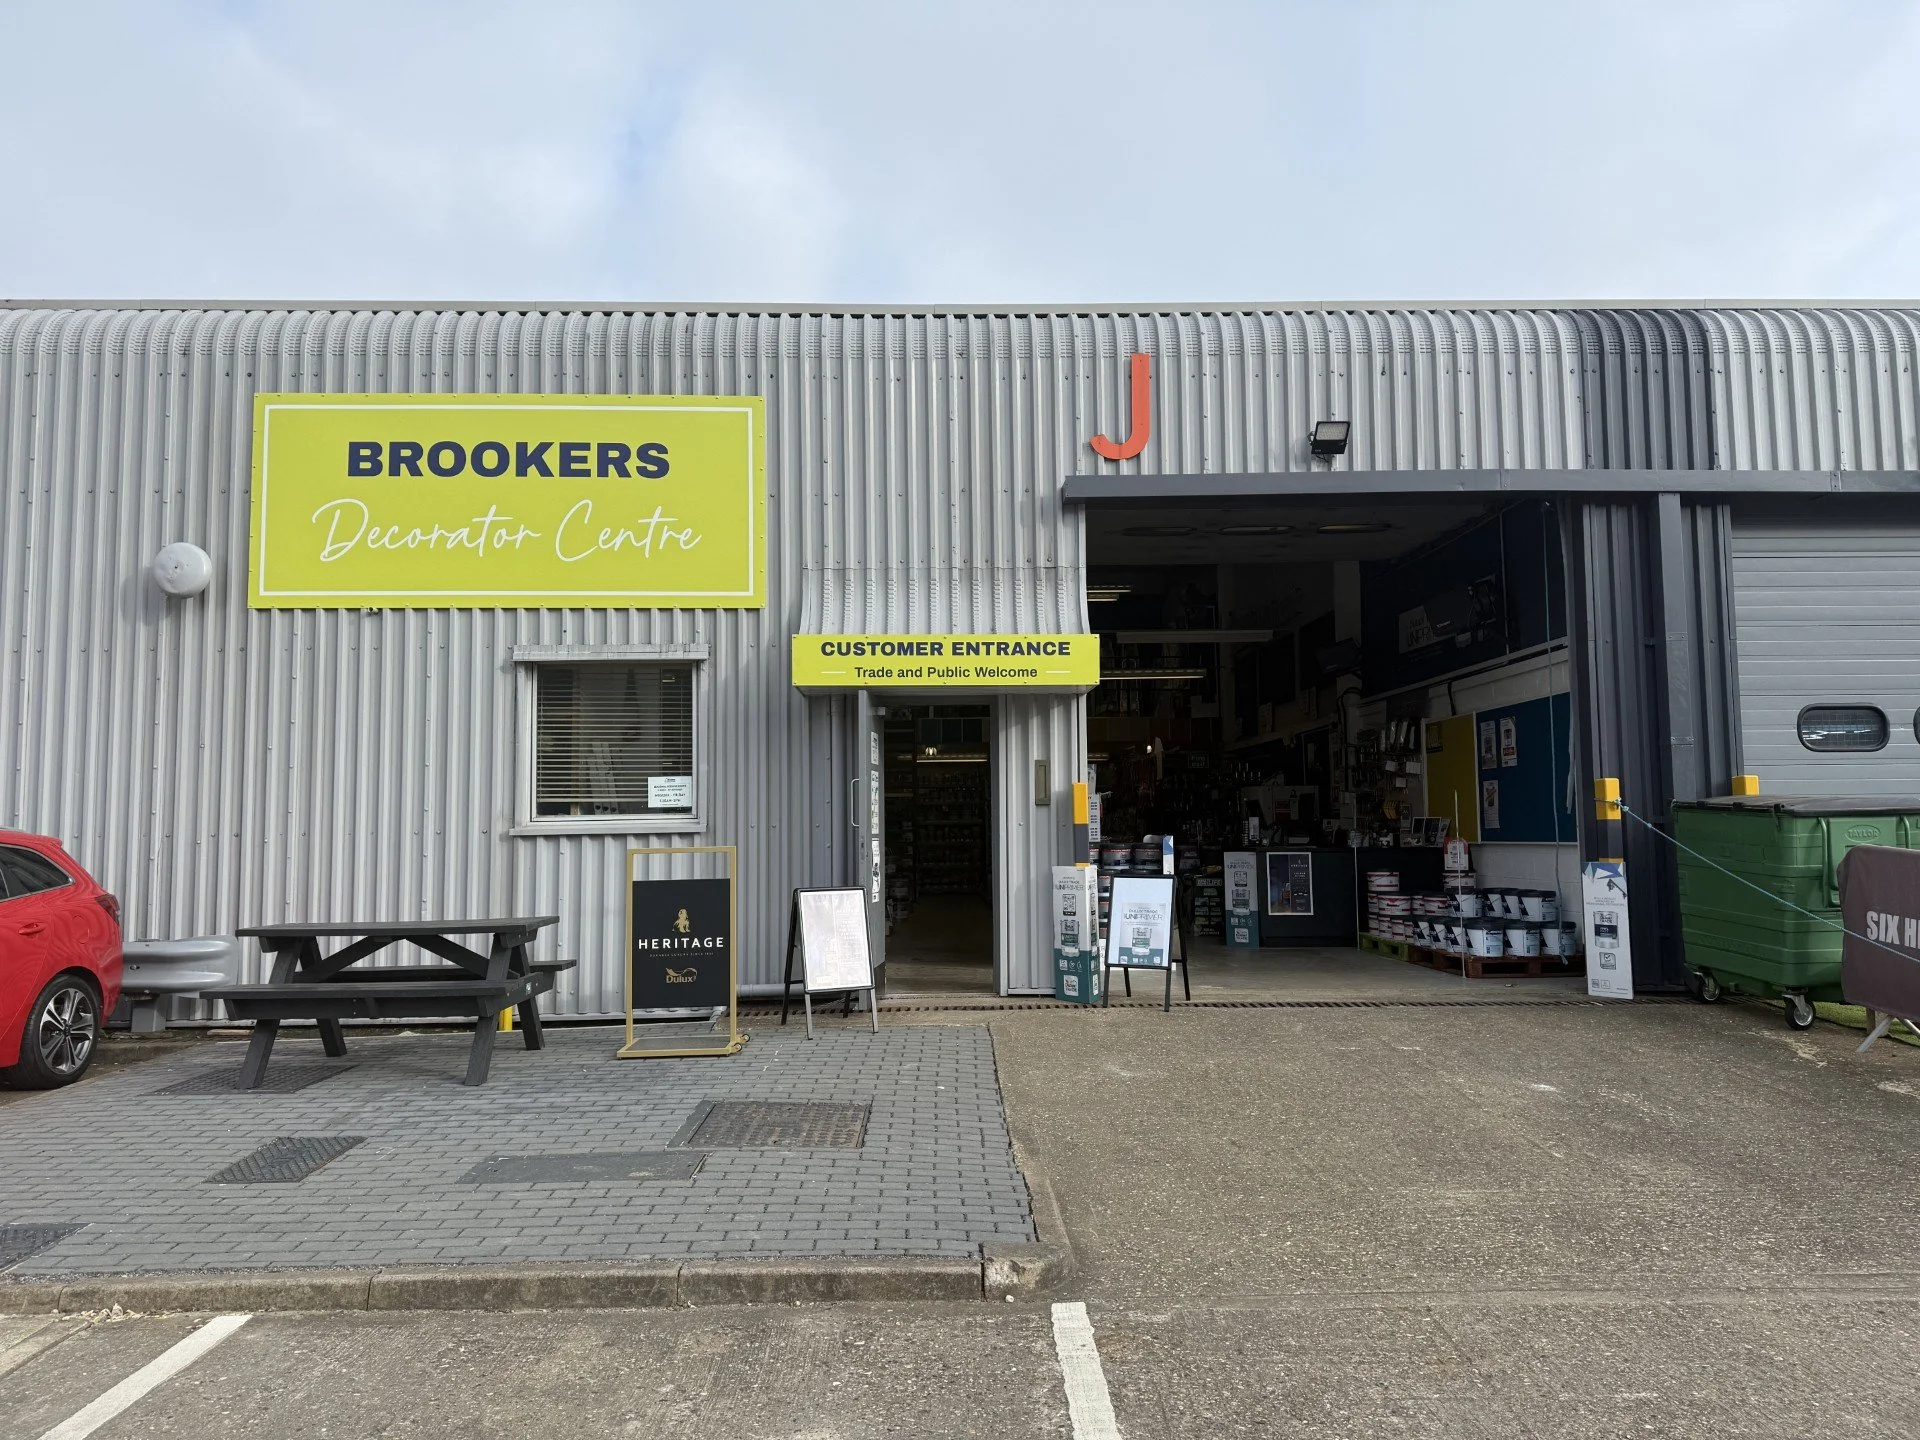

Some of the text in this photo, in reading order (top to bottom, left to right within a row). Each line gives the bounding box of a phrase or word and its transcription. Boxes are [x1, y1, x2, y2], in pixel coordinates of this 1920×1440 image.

[1089, 352, 1151, 460] J
[347, 440, 670, 479] BROOKERS
[311, 497, 702, 562] Decorator Centre
[820, 640, 1071, 657] CUSTOMER ENTRANCE
[854, 666, 1038, 678] Trade and Public Welcome
[1847, 828, 1880, 839] TAYLOR
[1866, 910, 1920, 950] SIX H
[638, 937, 724, 950] HERITAGE
[665, 974, 694, 984] Dulux
